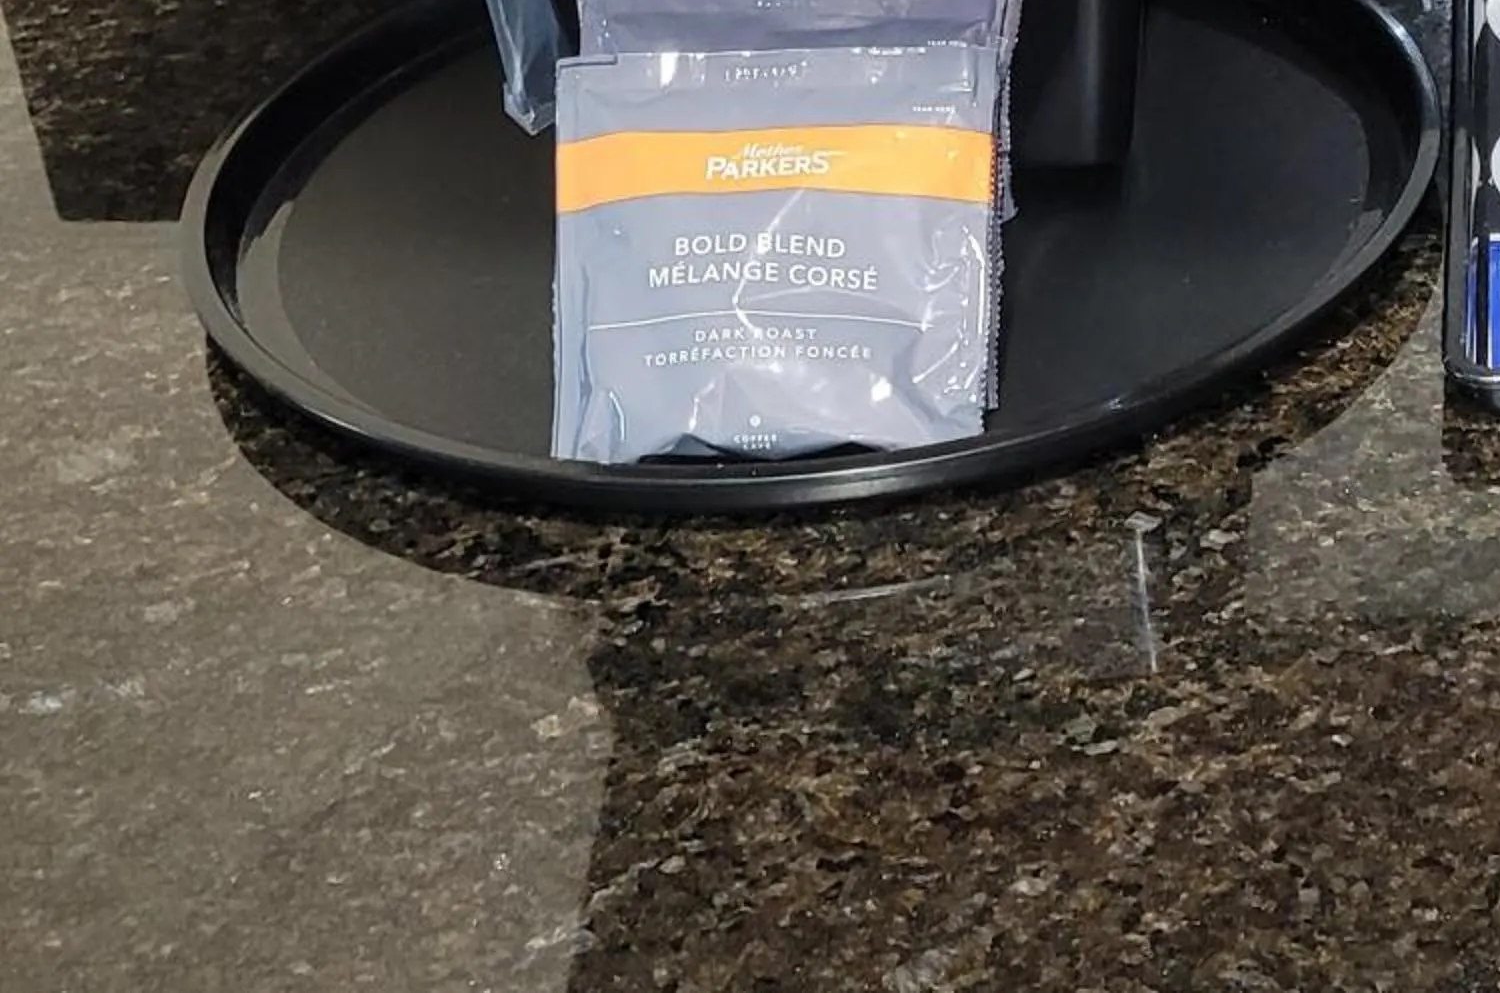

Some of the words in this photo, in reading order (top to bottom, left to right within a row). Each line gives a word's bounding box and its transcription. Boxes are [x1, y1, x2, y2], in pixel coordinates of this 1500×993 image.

[705, 150, 831, 180] PARKERS
[674, 232, 747, 256] BOLD
[756, 232, 845, 258] BLEND
[648, 259, 780, 288] MÉLANGE
[788, 264, 879, 290] CORSÉ
[695, 327, 745, 343] DARK
[753, 327, 818, 341] ROAST
[645, 344, 786, 368] TORRÉFACTION
[794, 344, 873, 359] FONCÉE
